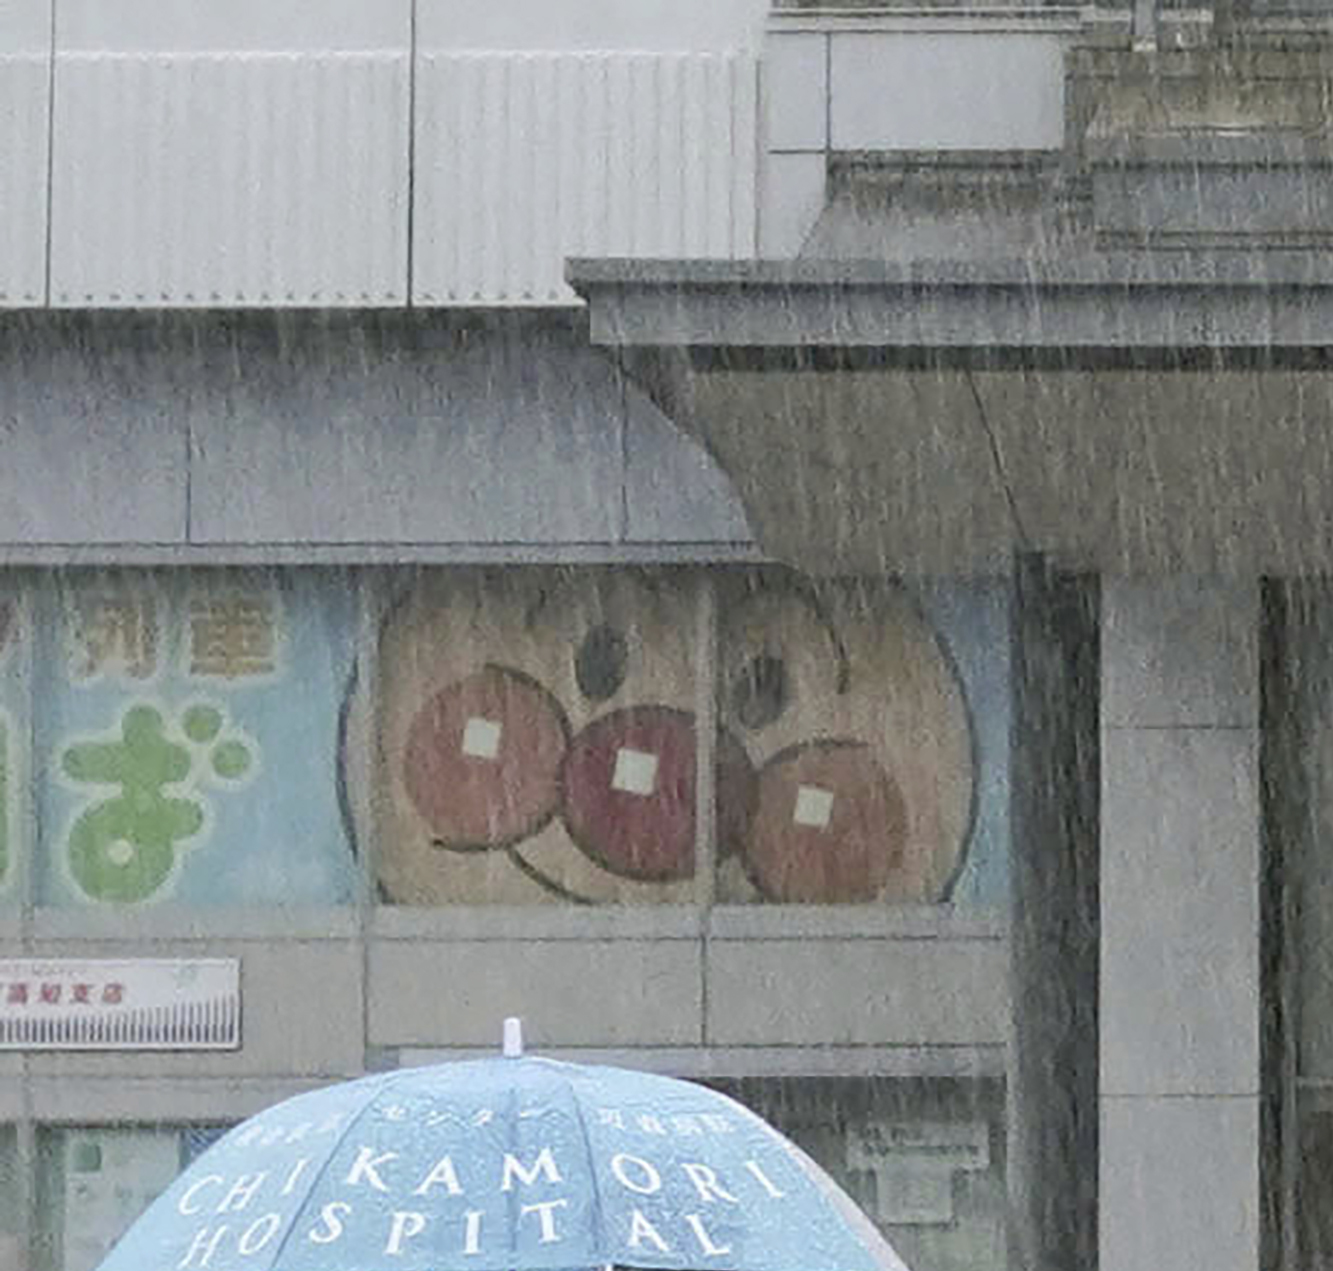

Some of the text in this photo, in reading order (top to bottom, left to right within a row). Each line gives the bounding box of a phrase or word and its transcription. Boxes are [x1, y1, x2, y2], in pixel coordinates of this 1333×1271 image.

[0, 983, 124, 1005] 高知支店
[178, 1146, 785, 1216] CHIKAMORI
[176, 1199, 731, 1270] HOSPITAL
